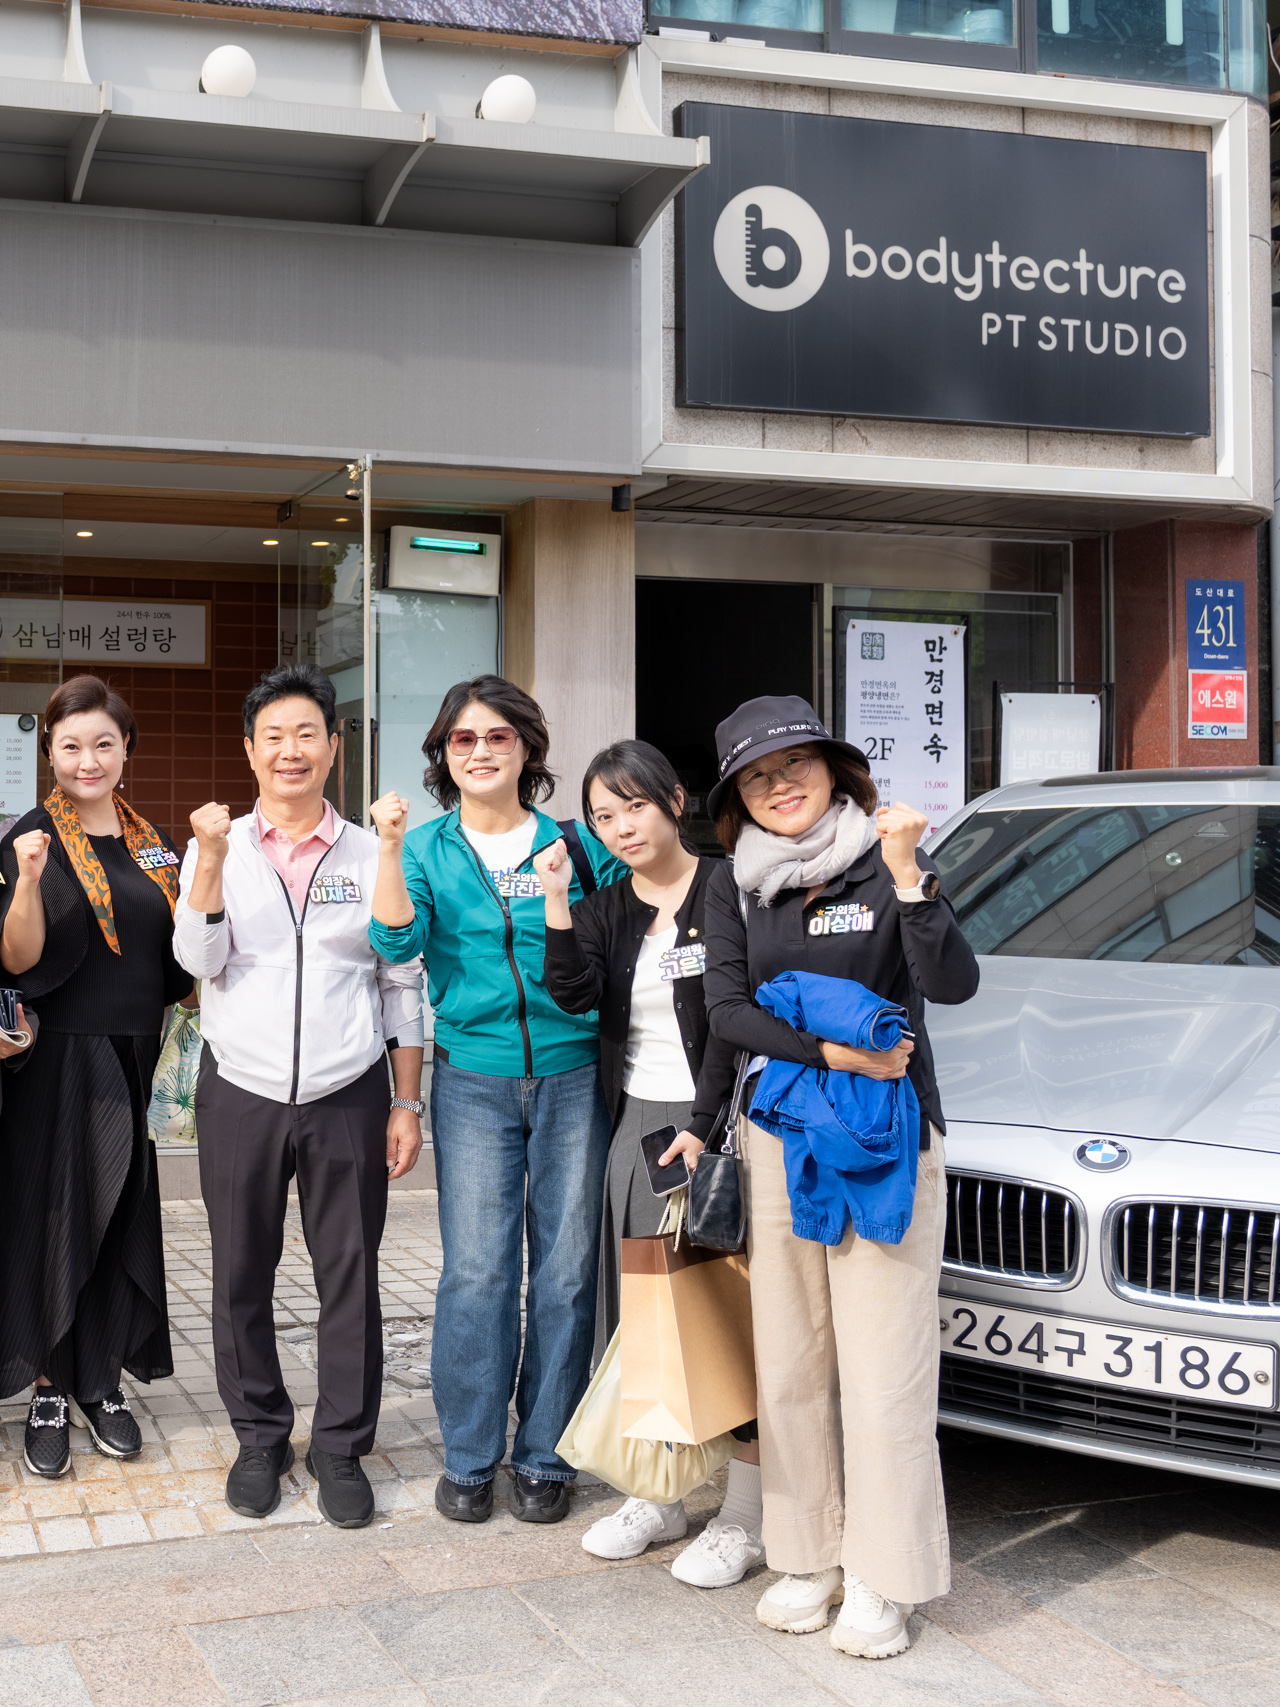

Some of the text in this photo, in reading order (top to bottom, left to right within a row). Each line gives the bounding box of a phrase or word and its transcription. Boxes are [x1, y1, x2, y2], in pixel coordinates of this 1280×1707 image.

[845, 228, 1187, 304] bodytecture
[981, 312, 1188, 361] PT STUDIO
[1195, 588, 1235, 597] 도산대로
[117, 610, 172, 620] 24시 한우 100%
[1195, 604, 1237, 647] 431
[12, 622, 177, 653] 삼남매 설렁탕
[861, 680, 897, 690] 만경면옥의
[860, 691, 900, 701] 평양냉면은?
[923, 636, 949, 764] 만경면옥
[1198, 690, 1237, 709] 에스원
[768, 727, 787, 736] PLAY
[788, 724, 807, 732] YOUR
[1192, 725, 1228, 736] SECOM
[864, 737, 895, 760] 2F
[872, 778, 949, 790] 냉면 15,000
[924, 803, 949, 812] 15,000
[135, 851, 180, 870] 김현정
[322, 875, 344, 886] 의장
[309, 885, 362, 903] 이재진
[824, 903, 860, 917] 구의원
[808, 911, 875, 937] 이상애
[669, 943, 704, 960] 구의원
[951, 1307, 1251, 1396] 264구 3186
